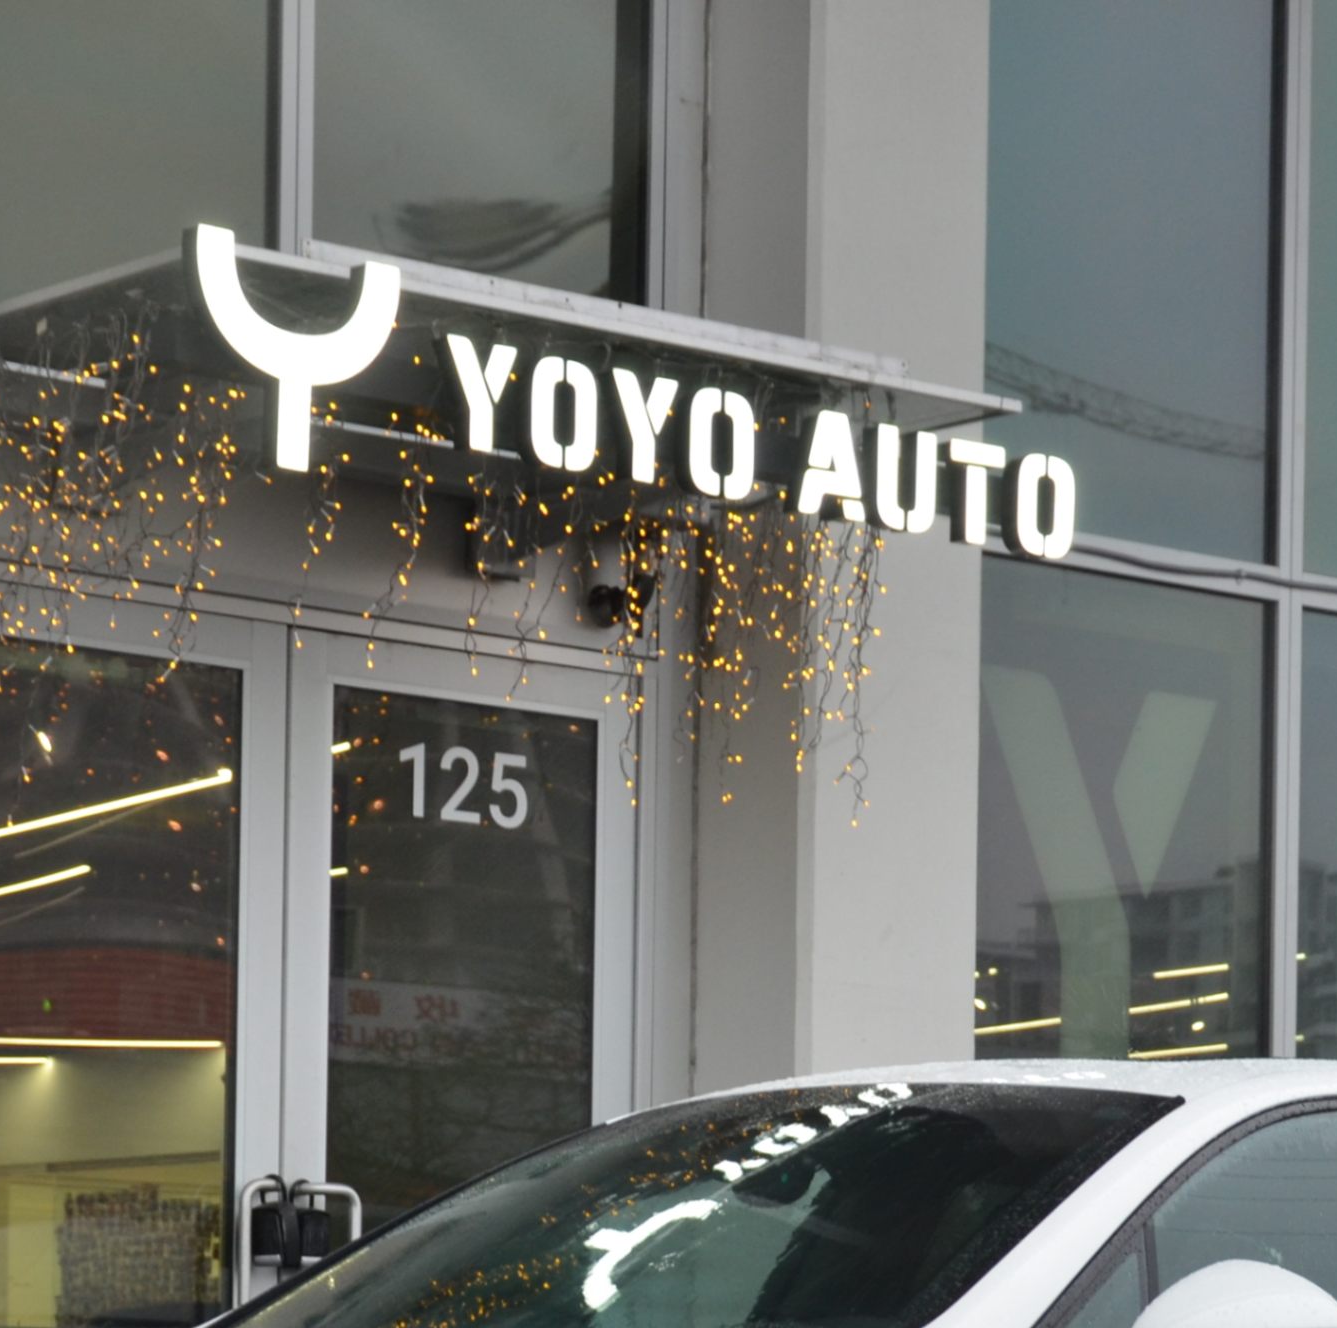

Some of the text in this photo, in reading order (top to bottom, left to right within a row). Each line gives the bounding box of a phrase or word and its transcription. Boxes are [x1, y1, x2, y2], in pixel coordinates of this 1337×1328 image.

[446, 332, 1077, 560] YOYO AUTO
[398, 742, 529, 830] 125
